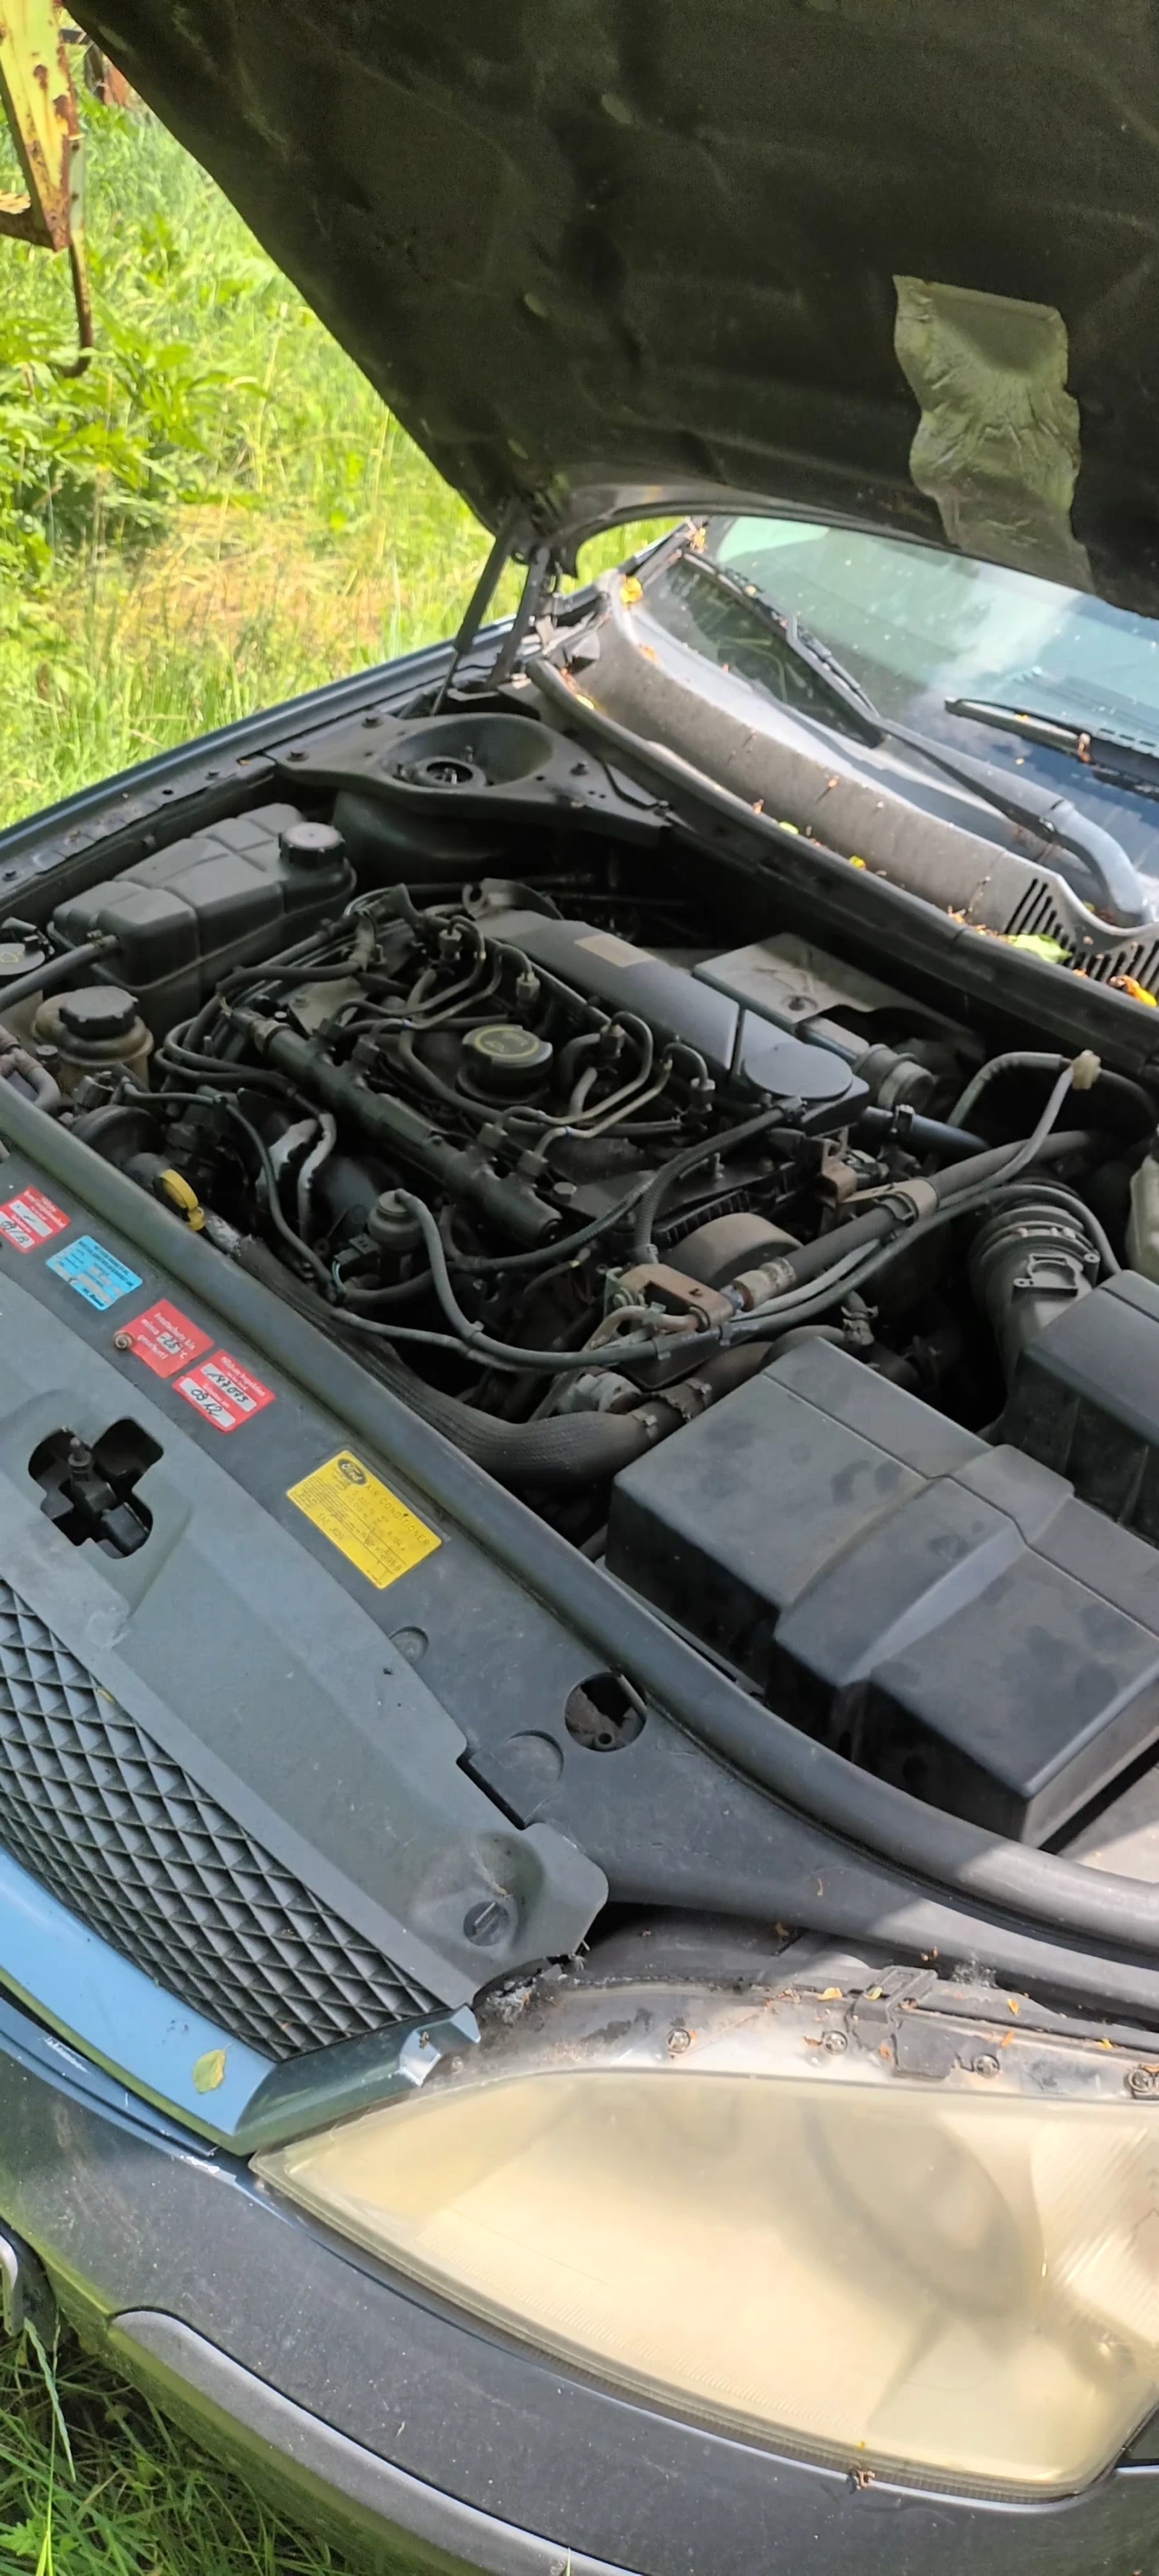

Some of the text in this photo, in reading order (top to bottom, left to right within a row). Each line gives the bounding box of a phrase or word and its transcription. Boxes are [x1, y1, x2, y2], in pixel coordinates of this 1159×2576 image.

[341, 1462, 364, 1481] Ford
[364, 1484, 379, 1497] AIR
[379, 1498, 430, 1546] CONDITIONER
